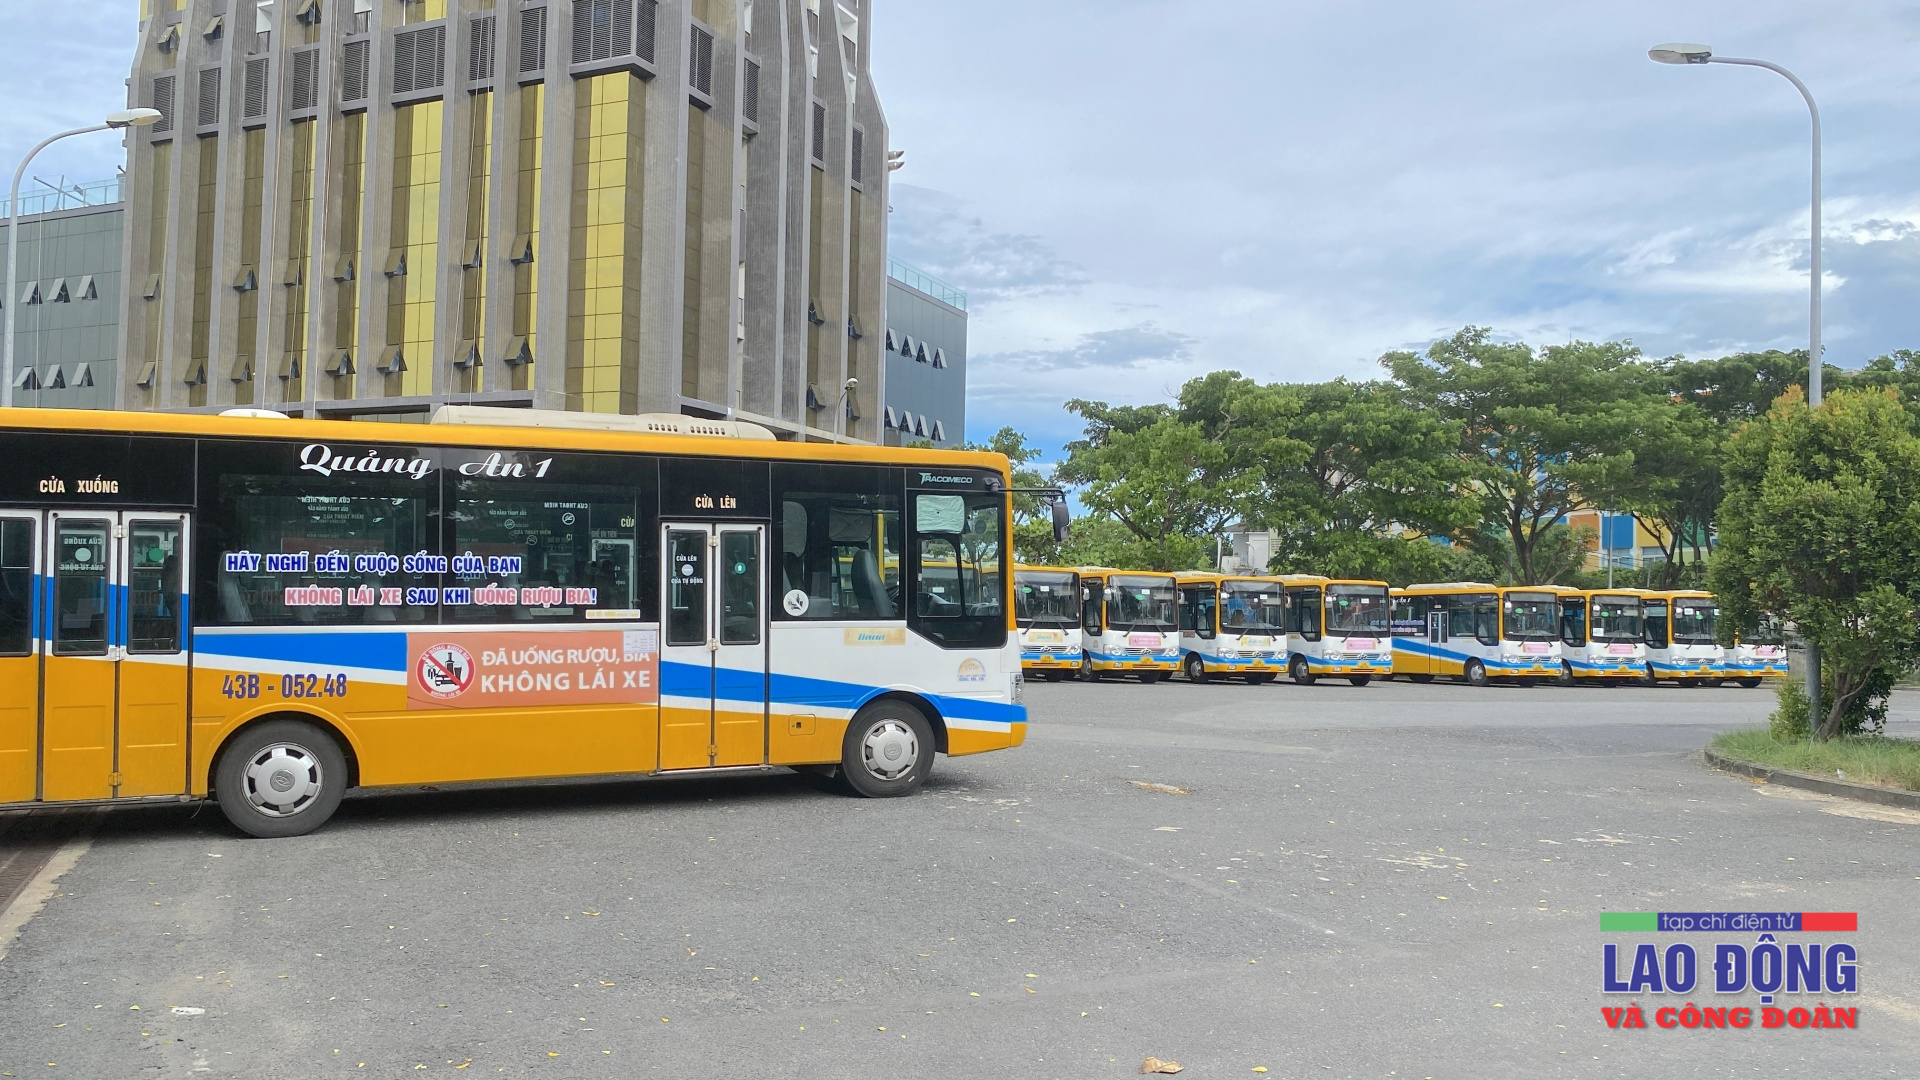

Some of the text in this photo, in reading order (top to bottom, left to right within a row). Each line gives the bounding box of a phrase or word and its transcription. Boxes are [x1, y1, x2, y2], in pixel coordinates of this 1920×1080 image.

[299, 443, 553, 480] Quảng An 1
[39, 474, 119, 493] CỬA XUỐNG
[918, 472, 973, 485] TRACOMECO
[694, 493, 737, 509] CỬA LÊN
[226, 551, 261, 572] HÃY
[266, 551, 310, 572] NGHĨ
[315, 550, 350, 573] ĐẾN
[354, 551, 400, 576] CUỘC
[403, 550, 448, 573] SỐNG
[452, 551, 485, 573] CỦA
[488, 556, 522, 577] BẠN
[285, 584, 342, 606] KHÔNG
[347, 584, 375, 605] LÁI
[379, 587, 402, 605] XE
[406, 587, 438, 605] SAU
[443, 587, 471, 605] KHI
[474, 582, 518, 605] UỐNG
[521, 586, 562, 608] RƯỢU
[482, 647, 508, 666] ĐÃ
[511, 645, 565, 665] UỐNG
[222, 674, 260, 699] 43B
[281, 673, 347, 698] 052.48
[481, 667, 651, 693] KHÔNG LÁI XE
